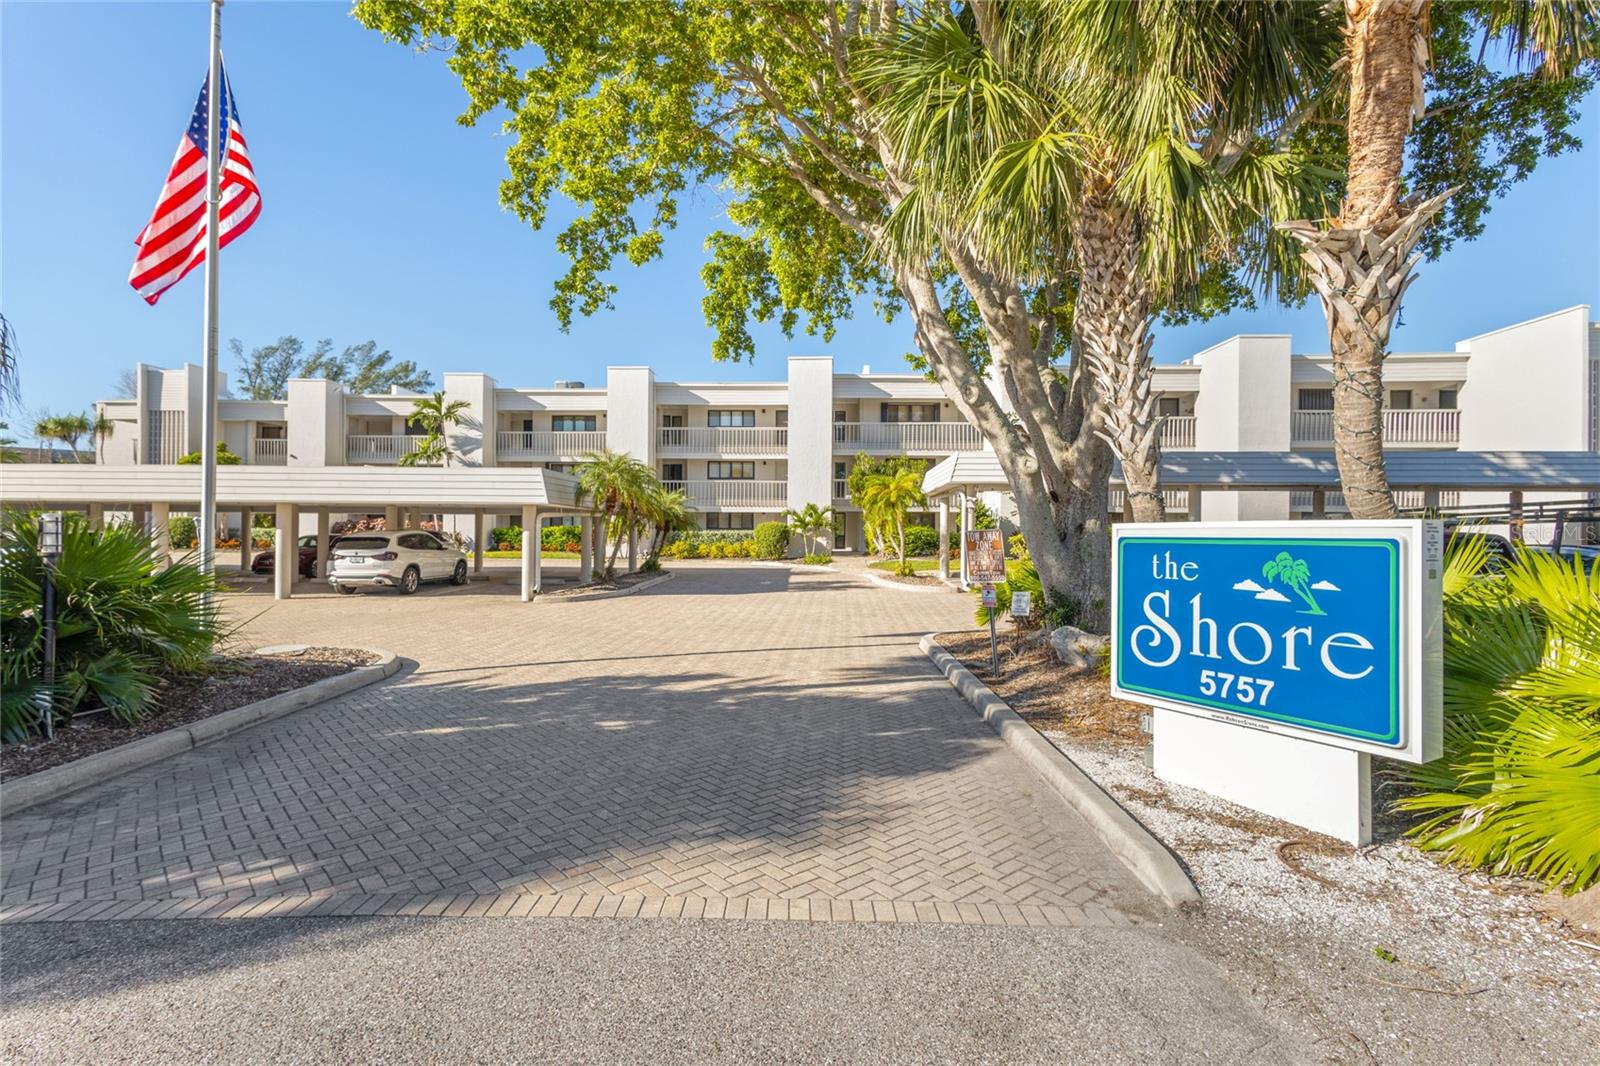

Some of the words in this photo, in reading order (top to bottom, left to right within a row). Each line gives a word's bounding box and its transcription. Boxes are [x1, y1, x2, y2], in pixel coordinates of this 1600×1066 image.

[968, 532, 980, 542] TOW
[983, 531, 1000, 541] AWAY
[976, 540, 993, 551] ZONE
[1152, 550, 1199, 581] the
[1130, 589, 1375, 679] Shore
[1199, 669, 1275, 706] 5757
